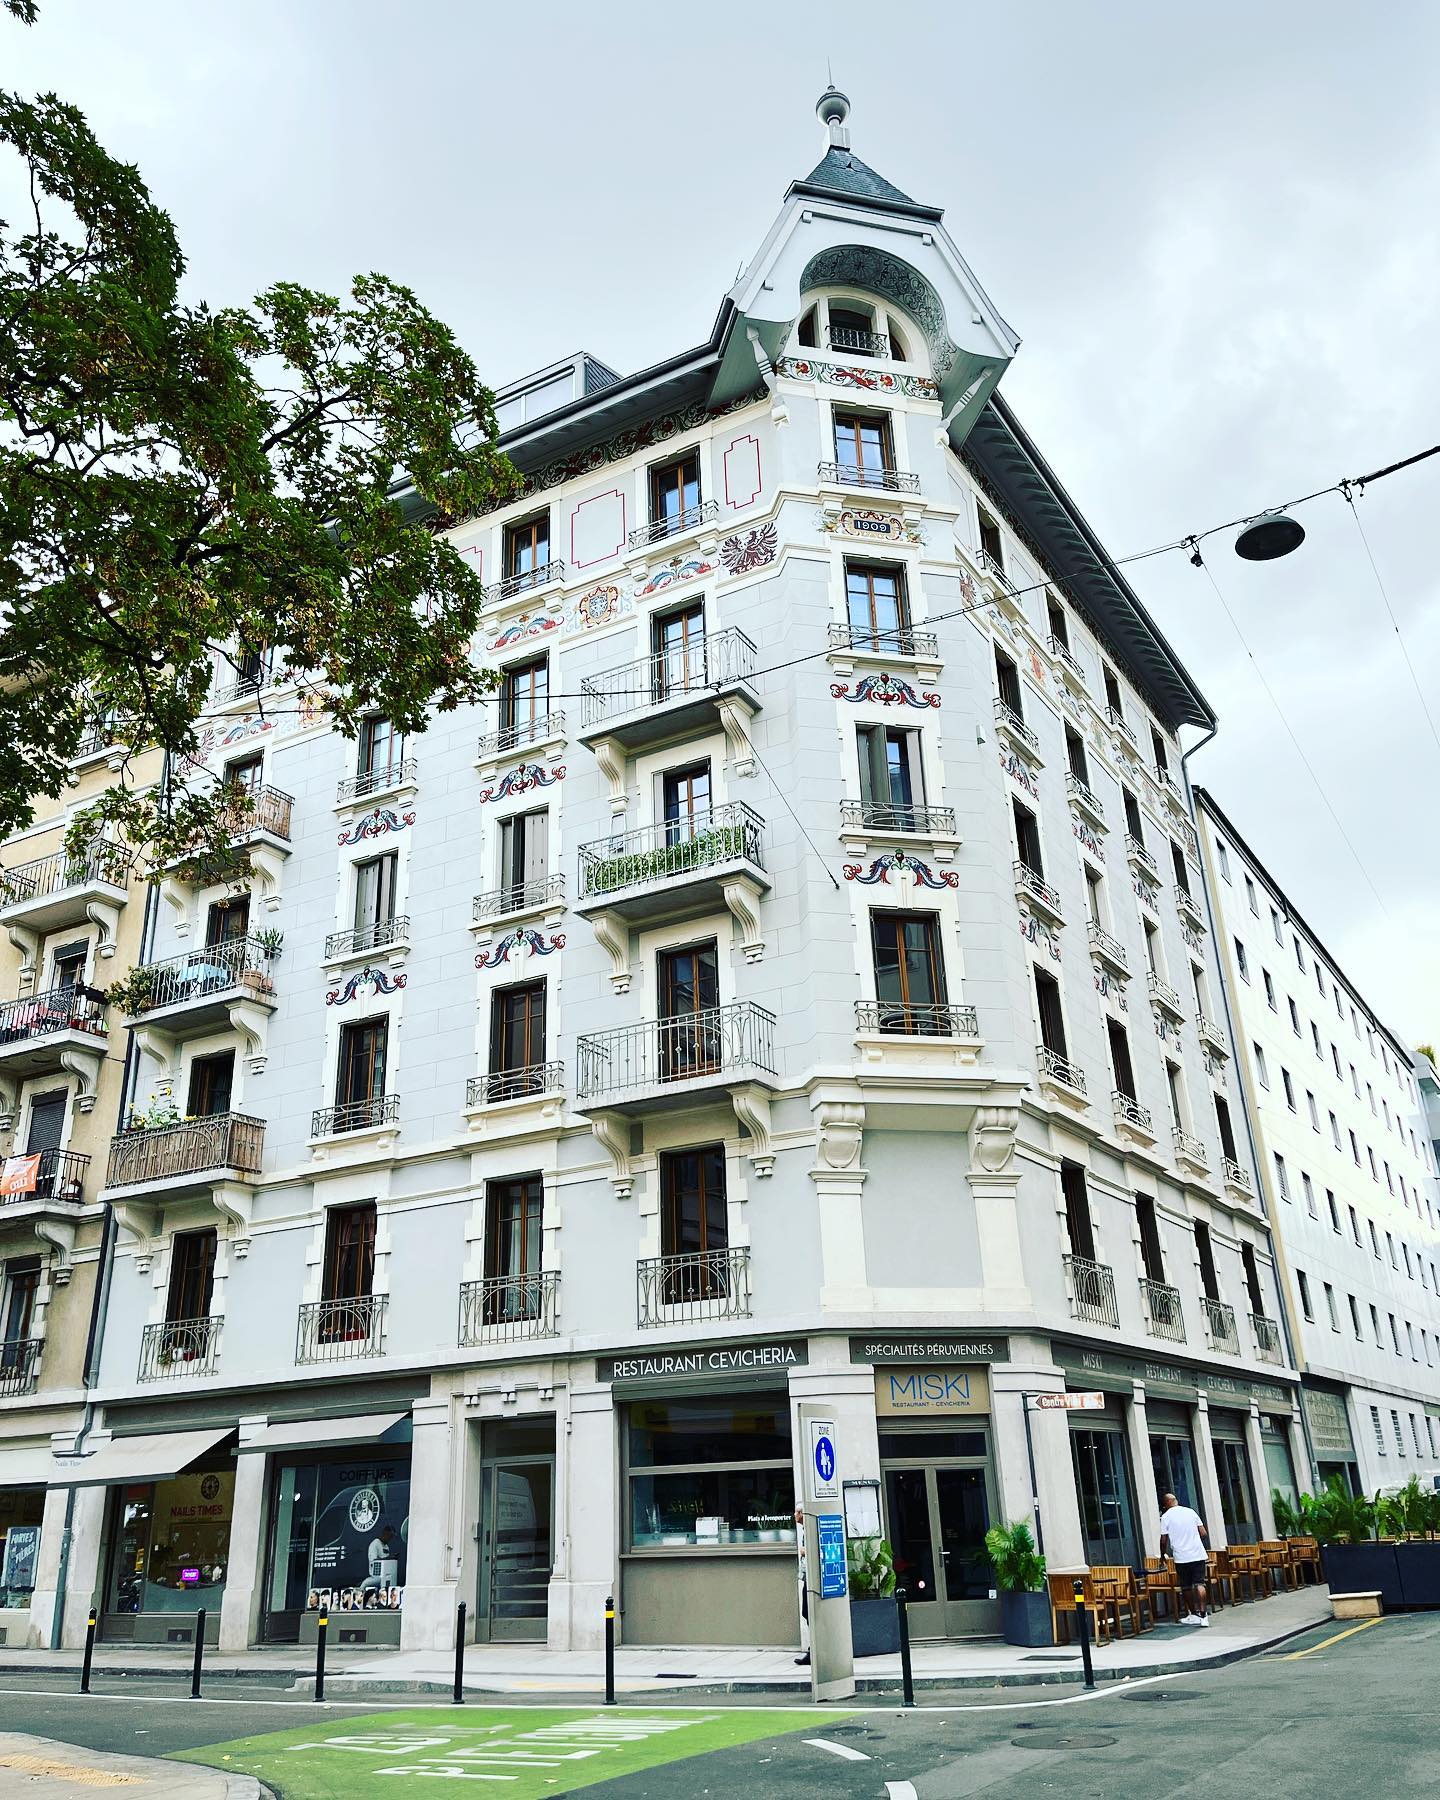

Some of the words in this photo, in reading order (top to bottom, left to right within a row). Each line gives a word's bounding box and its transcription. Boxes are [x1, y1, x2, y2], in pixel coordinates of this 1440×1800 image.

[857, 520, 888, 532] 1909
[865, 1343, 925, 1356] SPÉCIALITÉS
[927, 1343, 994, 1356] PÉRUVIENNES
[613, 1354, 705, 1378] RESTAURANT
[709, 1347, 797, 1369] CEVICHERIA
[1082, 1352, 1103, 1370] MISKI
[1145, 1363, 1182, 1382] RESTAURANT
[889, 1374, 970, 1401] MISKI
[1041, 1394, 1065, 1408] Centre
[339, 1468, 395, 1481] COIFFURE
[171, 1505, 196, 1517] NAILS
[197, 1503, 223, 1516] TIMES
